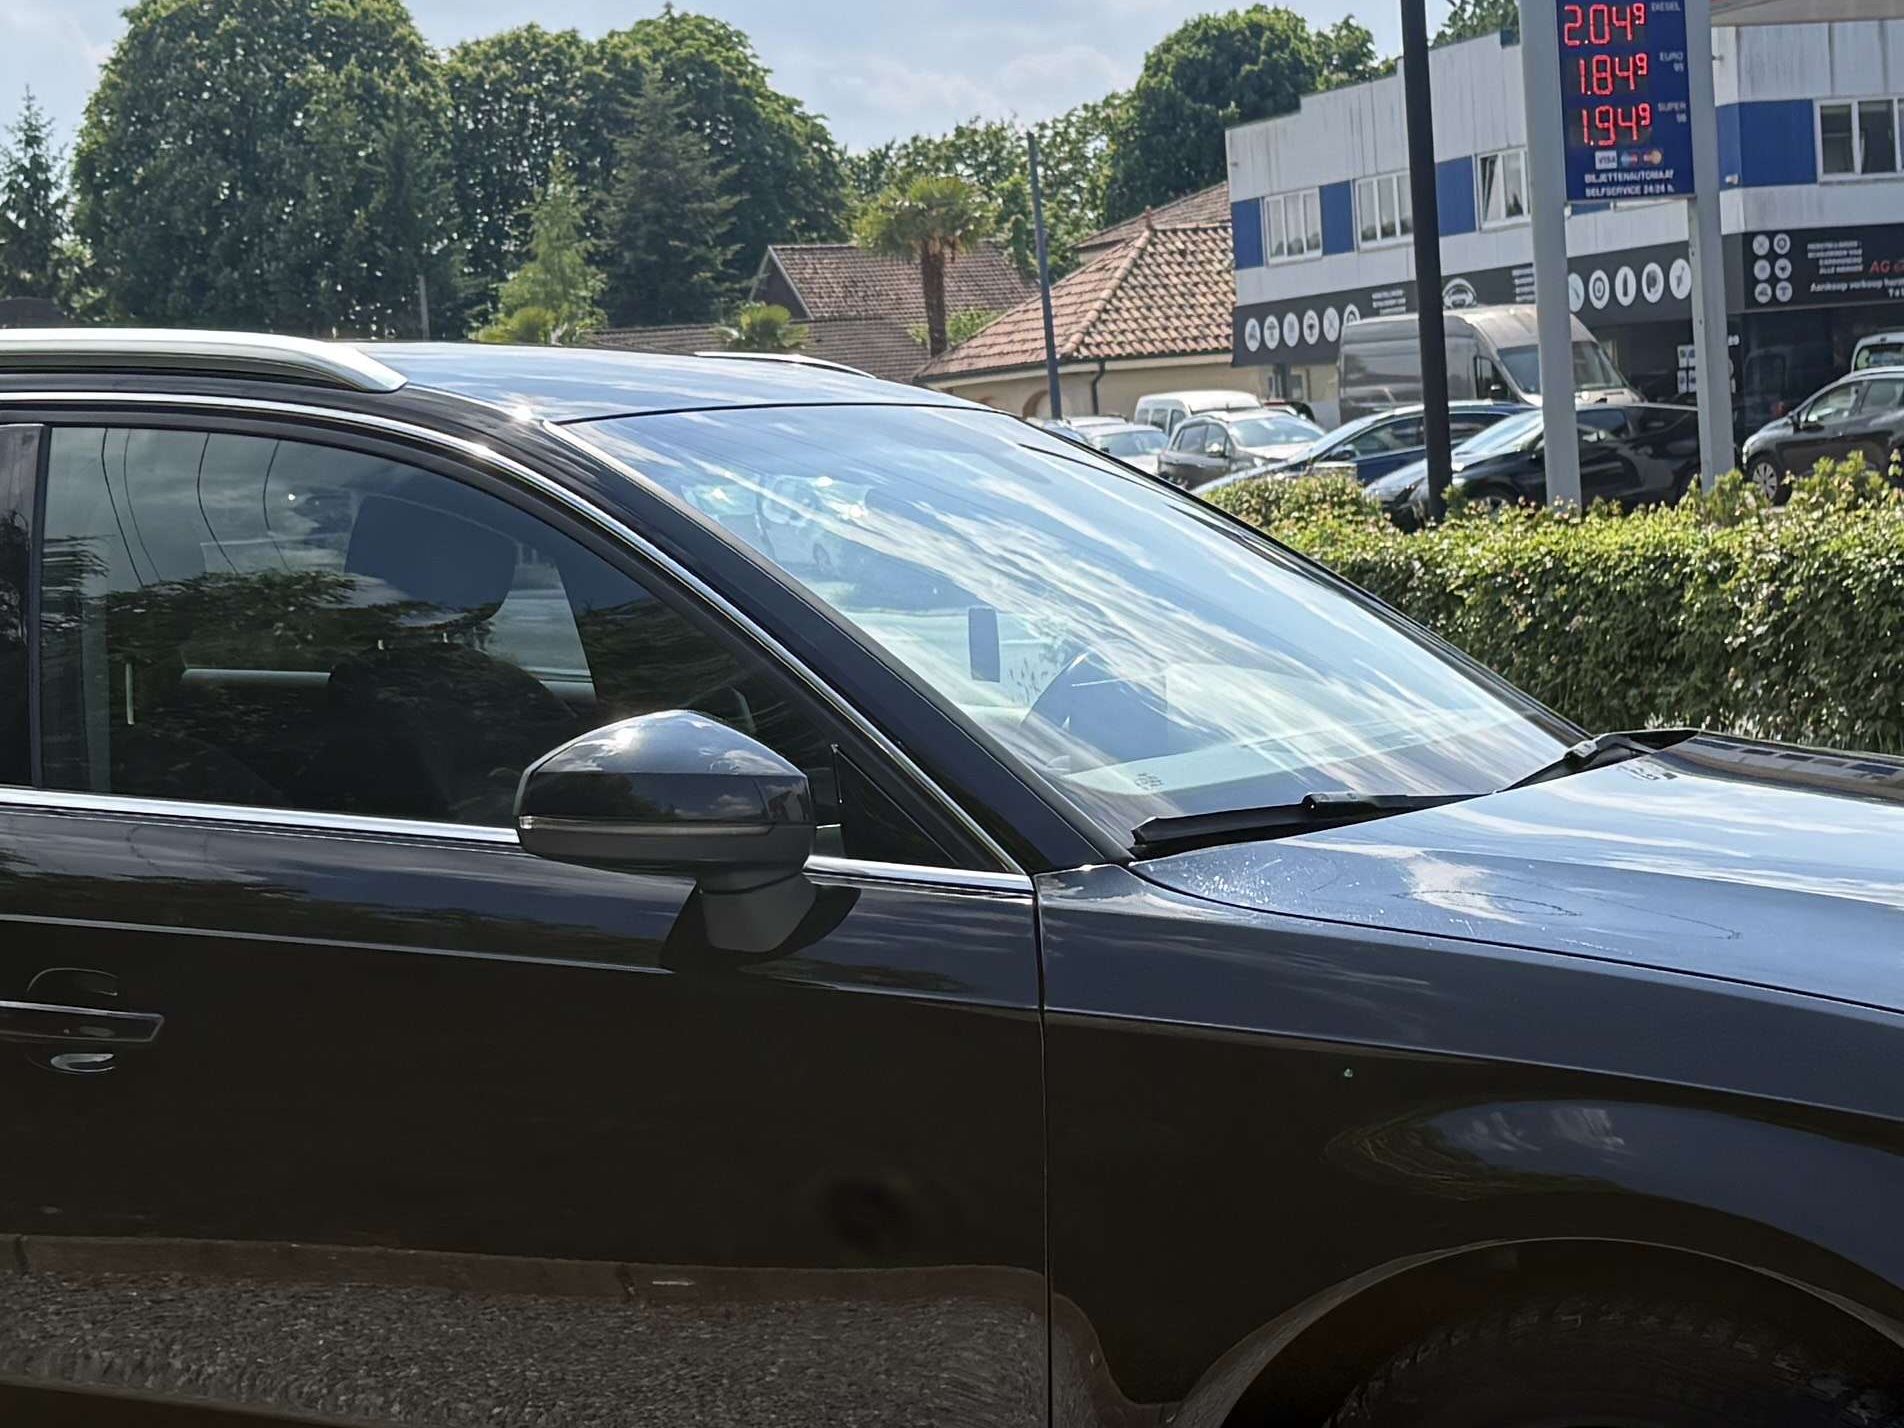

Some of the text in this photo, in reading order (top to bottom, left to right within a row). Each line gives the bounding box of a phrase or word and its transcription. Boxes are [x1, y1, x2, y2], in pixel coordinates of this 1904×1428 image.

[1563, 2, 1646, 47] 2.049
[1578, 52, 1648, 96] 1.849
[1581, 101, 1652, 147] 1.949
[1871, 260, 1891, 274] AG
